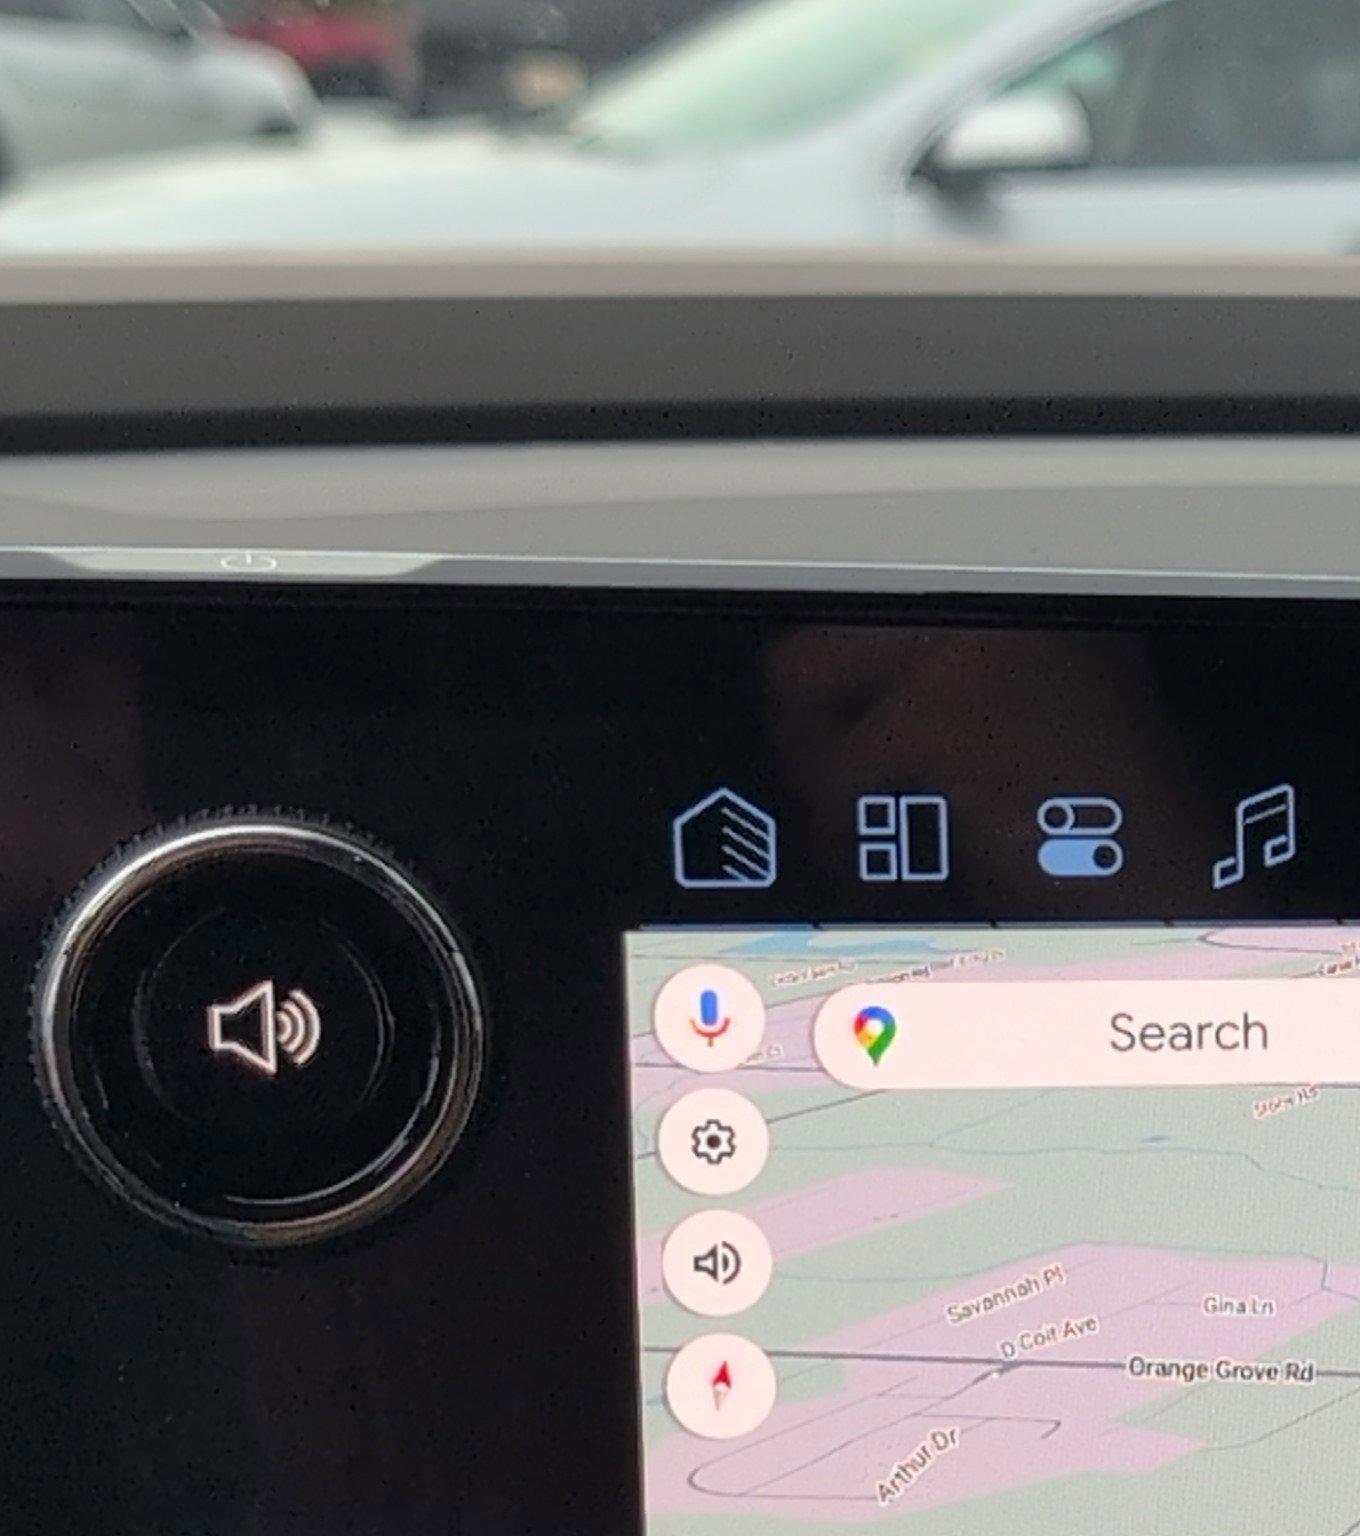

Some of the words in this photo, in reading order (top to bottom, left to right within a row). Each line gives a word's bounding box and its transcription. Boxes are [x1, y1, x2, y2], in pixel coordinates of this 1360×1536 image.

[1109, 1011, 1269, 1052] Search
[947, 1276, 1042, 1324] Savannah
[1043, 1264, 1066, 1289] Pl
[1202, 1297, 1248, 1317] Gina
[1251, 1298, 1275, 1316] Ln
[1000, 1340, 1017, 1361] D
[1020, 1328, 1058, 1354] Coit
[1061, 1315, 1099, 1338] Ave
[1128, 1355, 1210, 1384] Orange
[1214, 1359, 1280, 1383] Grove
[1285, 1361, 1316, 1384] Rd
[878, 1445, 935, 1504] Arthur
[930, 1427, 961, 1455] Dr
